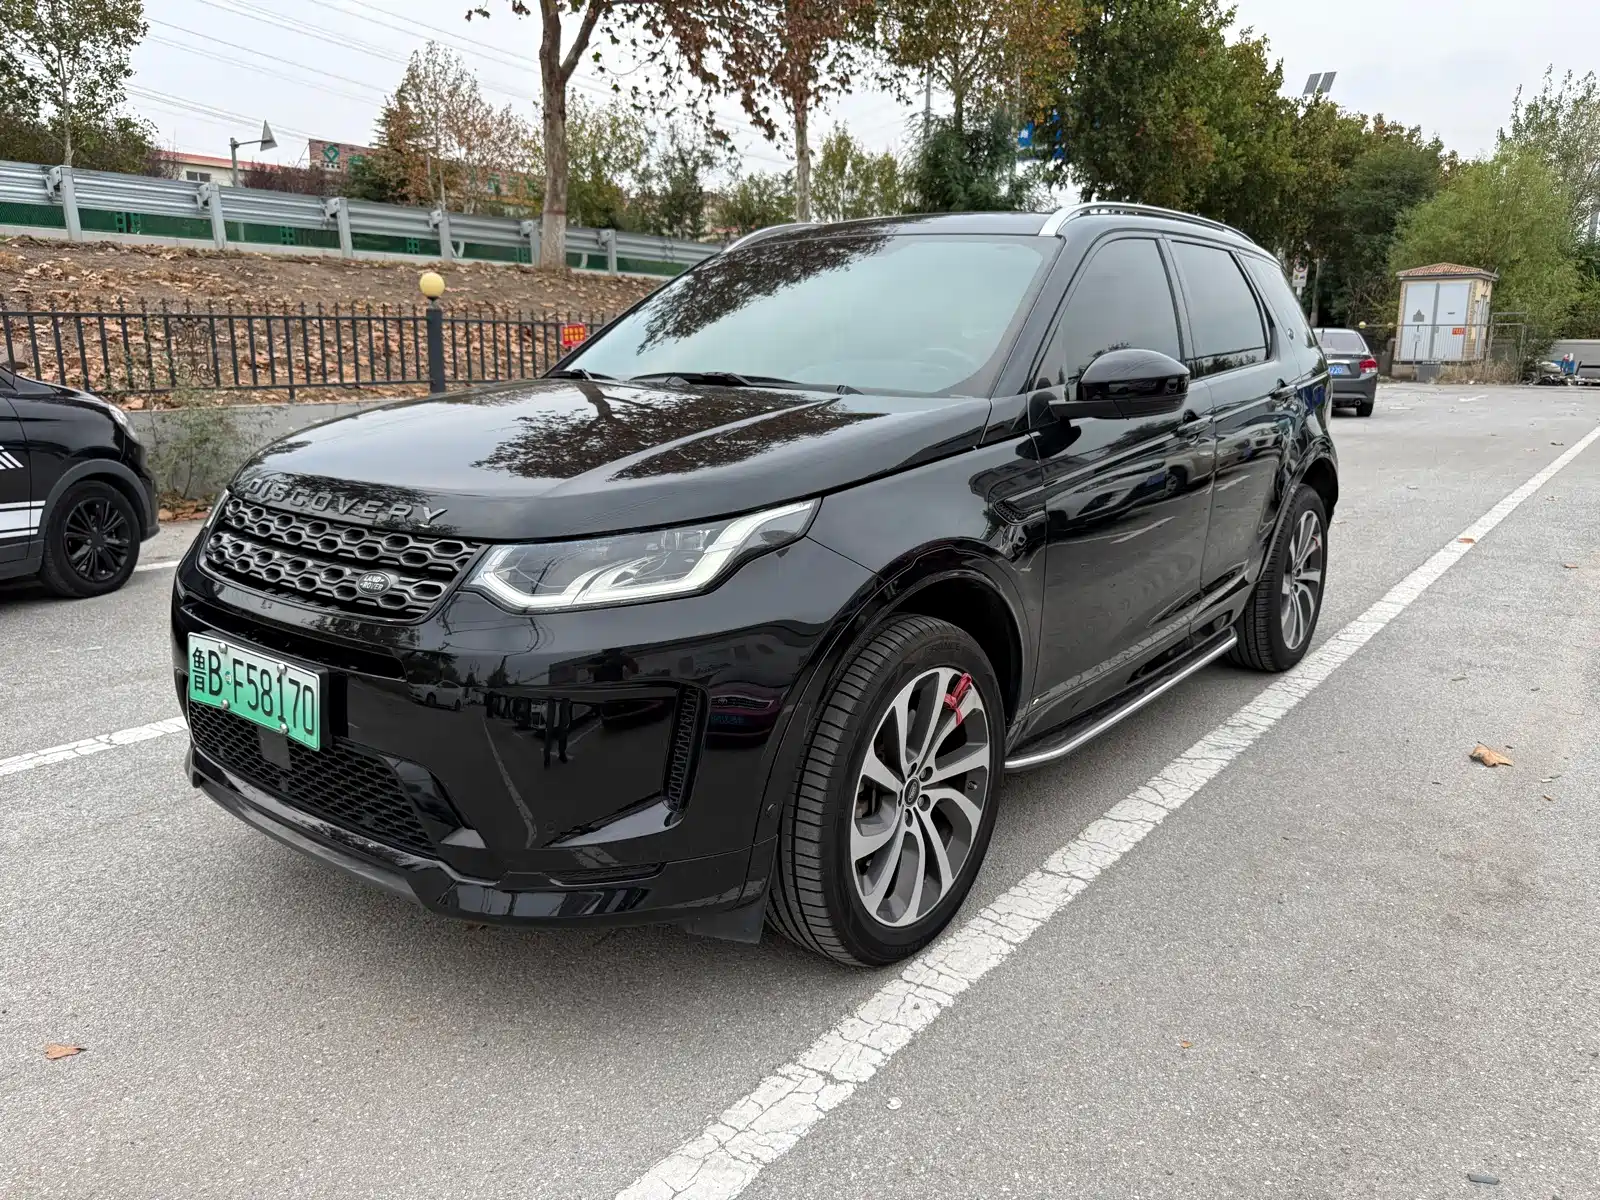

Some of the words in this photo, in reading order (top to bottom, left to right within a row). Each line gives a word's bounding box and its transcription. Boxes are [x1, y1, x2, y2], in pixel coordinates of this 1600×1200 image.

[249, 478, 448, 528] DISCOVERY
[364, 575, 382, 583] LAND
[362, 581, 384, 591] ROVER
